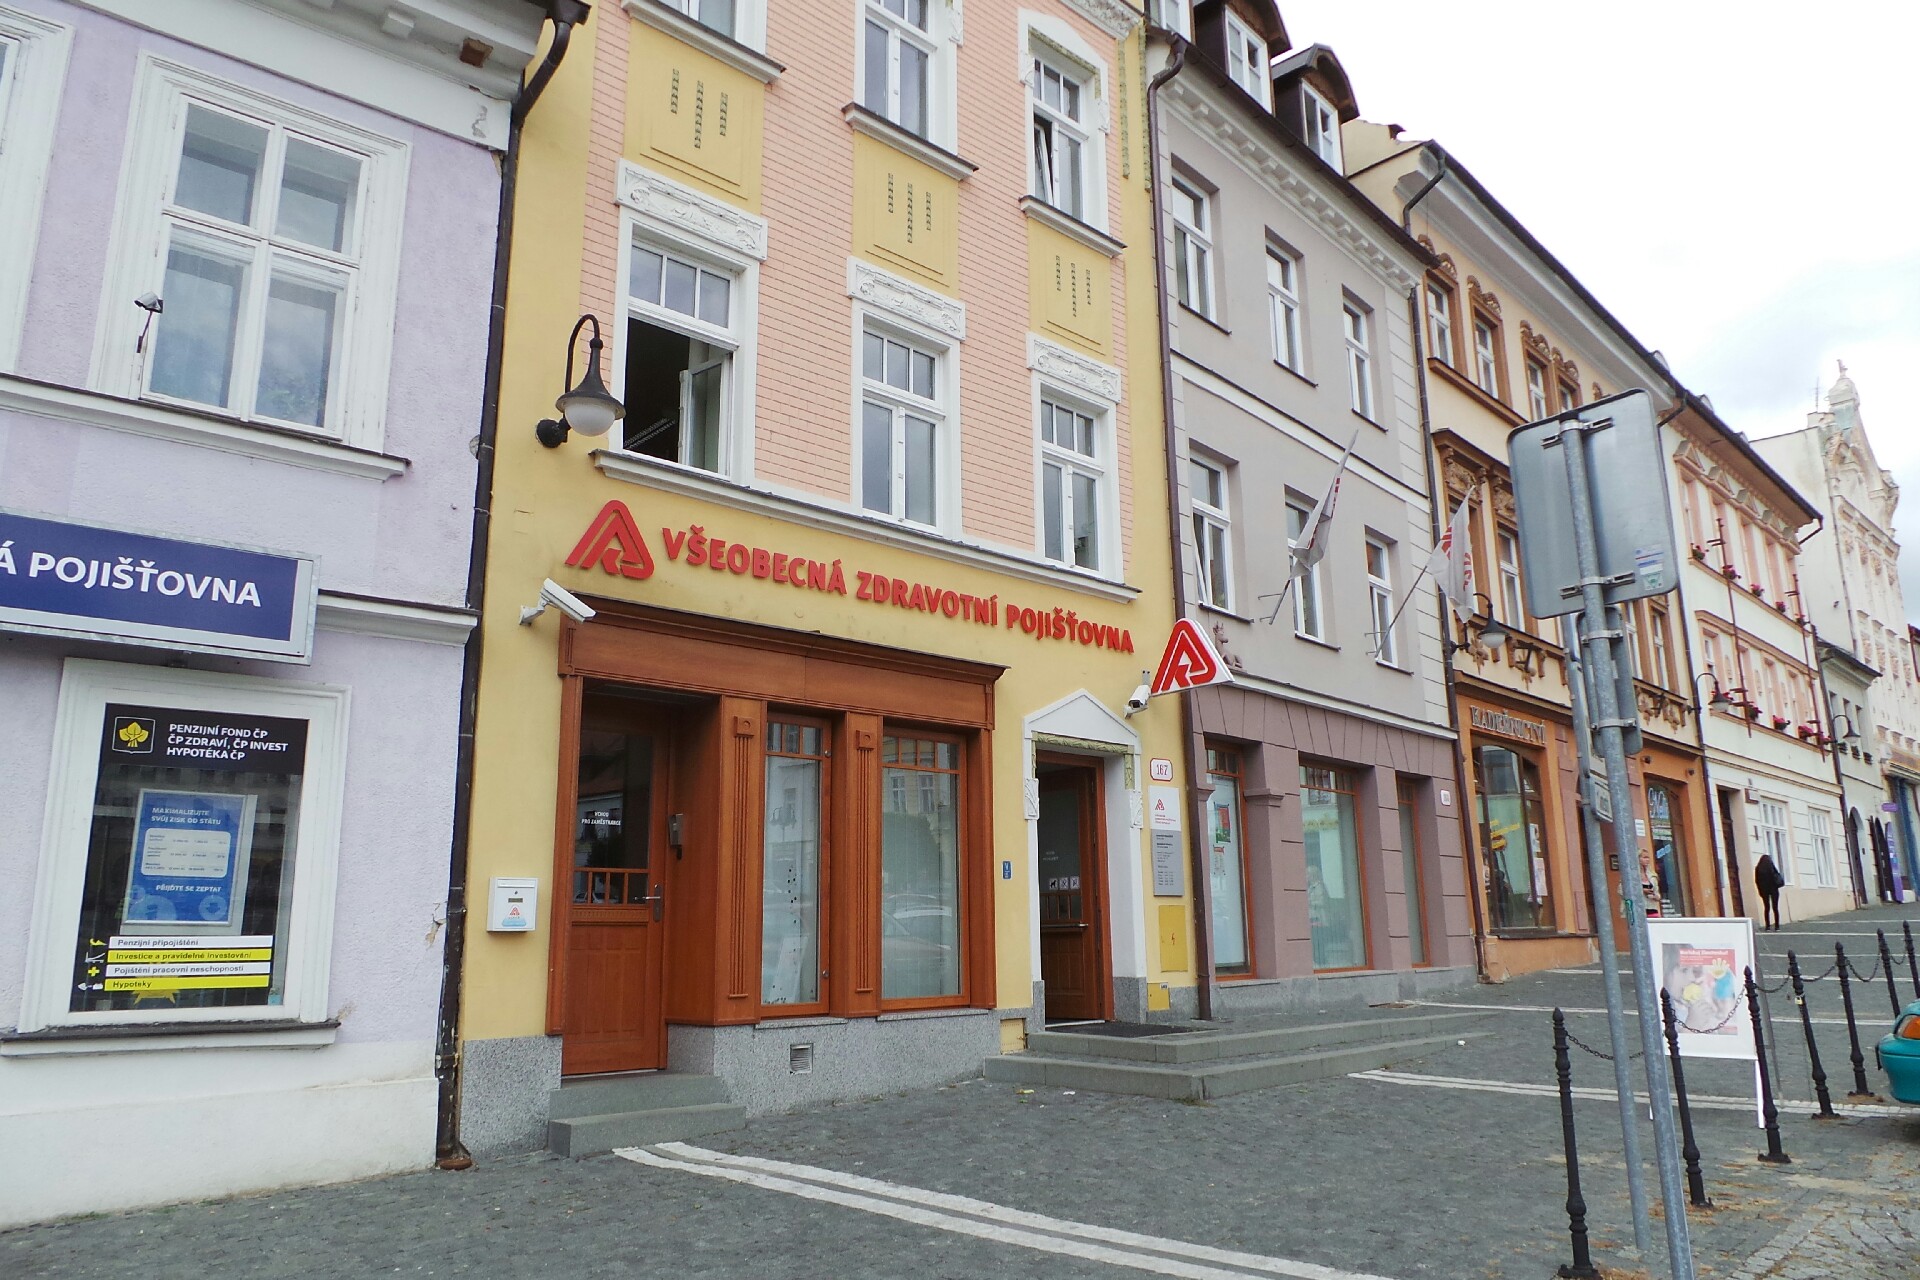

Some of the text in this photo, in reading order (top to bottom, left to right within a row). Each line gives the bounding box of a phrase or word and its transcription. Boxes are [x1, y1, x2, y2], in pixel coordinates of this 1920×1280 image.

[29, 551, 261, 607] POJIŠŤOVNA
[662, 524, 1134, 654] VŠEOBECNÁ ZDRAVOTNÍ POJIŠŤOVNA
[169, 723, 268, 739] PENZIJNÍ FOND ČP
[1470, 705, 1545, 744] KADEŘNICTVÍ
[167, 733, 288, 752] ČP ZDRAVÍ, ČP INVEST
[166, 746, 245, 760] HYPOTÉKA ČP
[1156, 764, 1168, 776] 167
[152, 807, 210, 817] MAXIMALIZUJTE
[116, 952, 153, 960] Investice
[190, 965, 244, 973] neschopnosti
